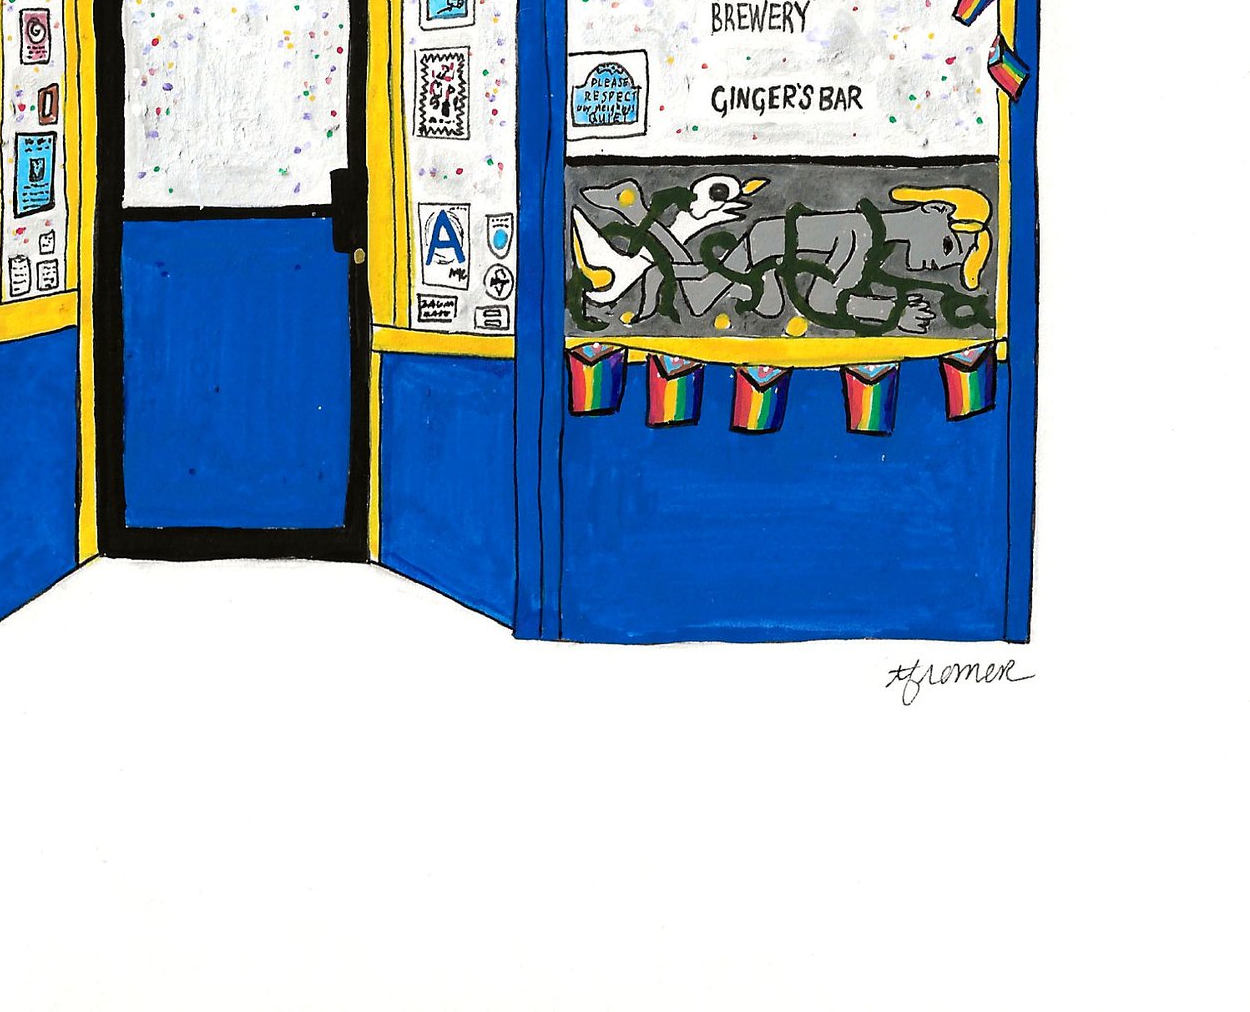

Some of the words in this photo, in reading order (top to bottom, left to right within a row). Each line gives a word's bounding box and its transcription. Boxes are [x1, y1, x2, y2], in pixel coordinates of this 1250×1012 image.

[711, 0, 811, 34] BREWERY
[591, 77, 629, 88] PLEASE
[584, 90, 637, 103] RESPECT
[711, 83, 814, 118] GINGER'S
[819, 85, 863, 112] BAR
[589, 112, 627, 124] QUIET
[425, 209, 466, 267] A
